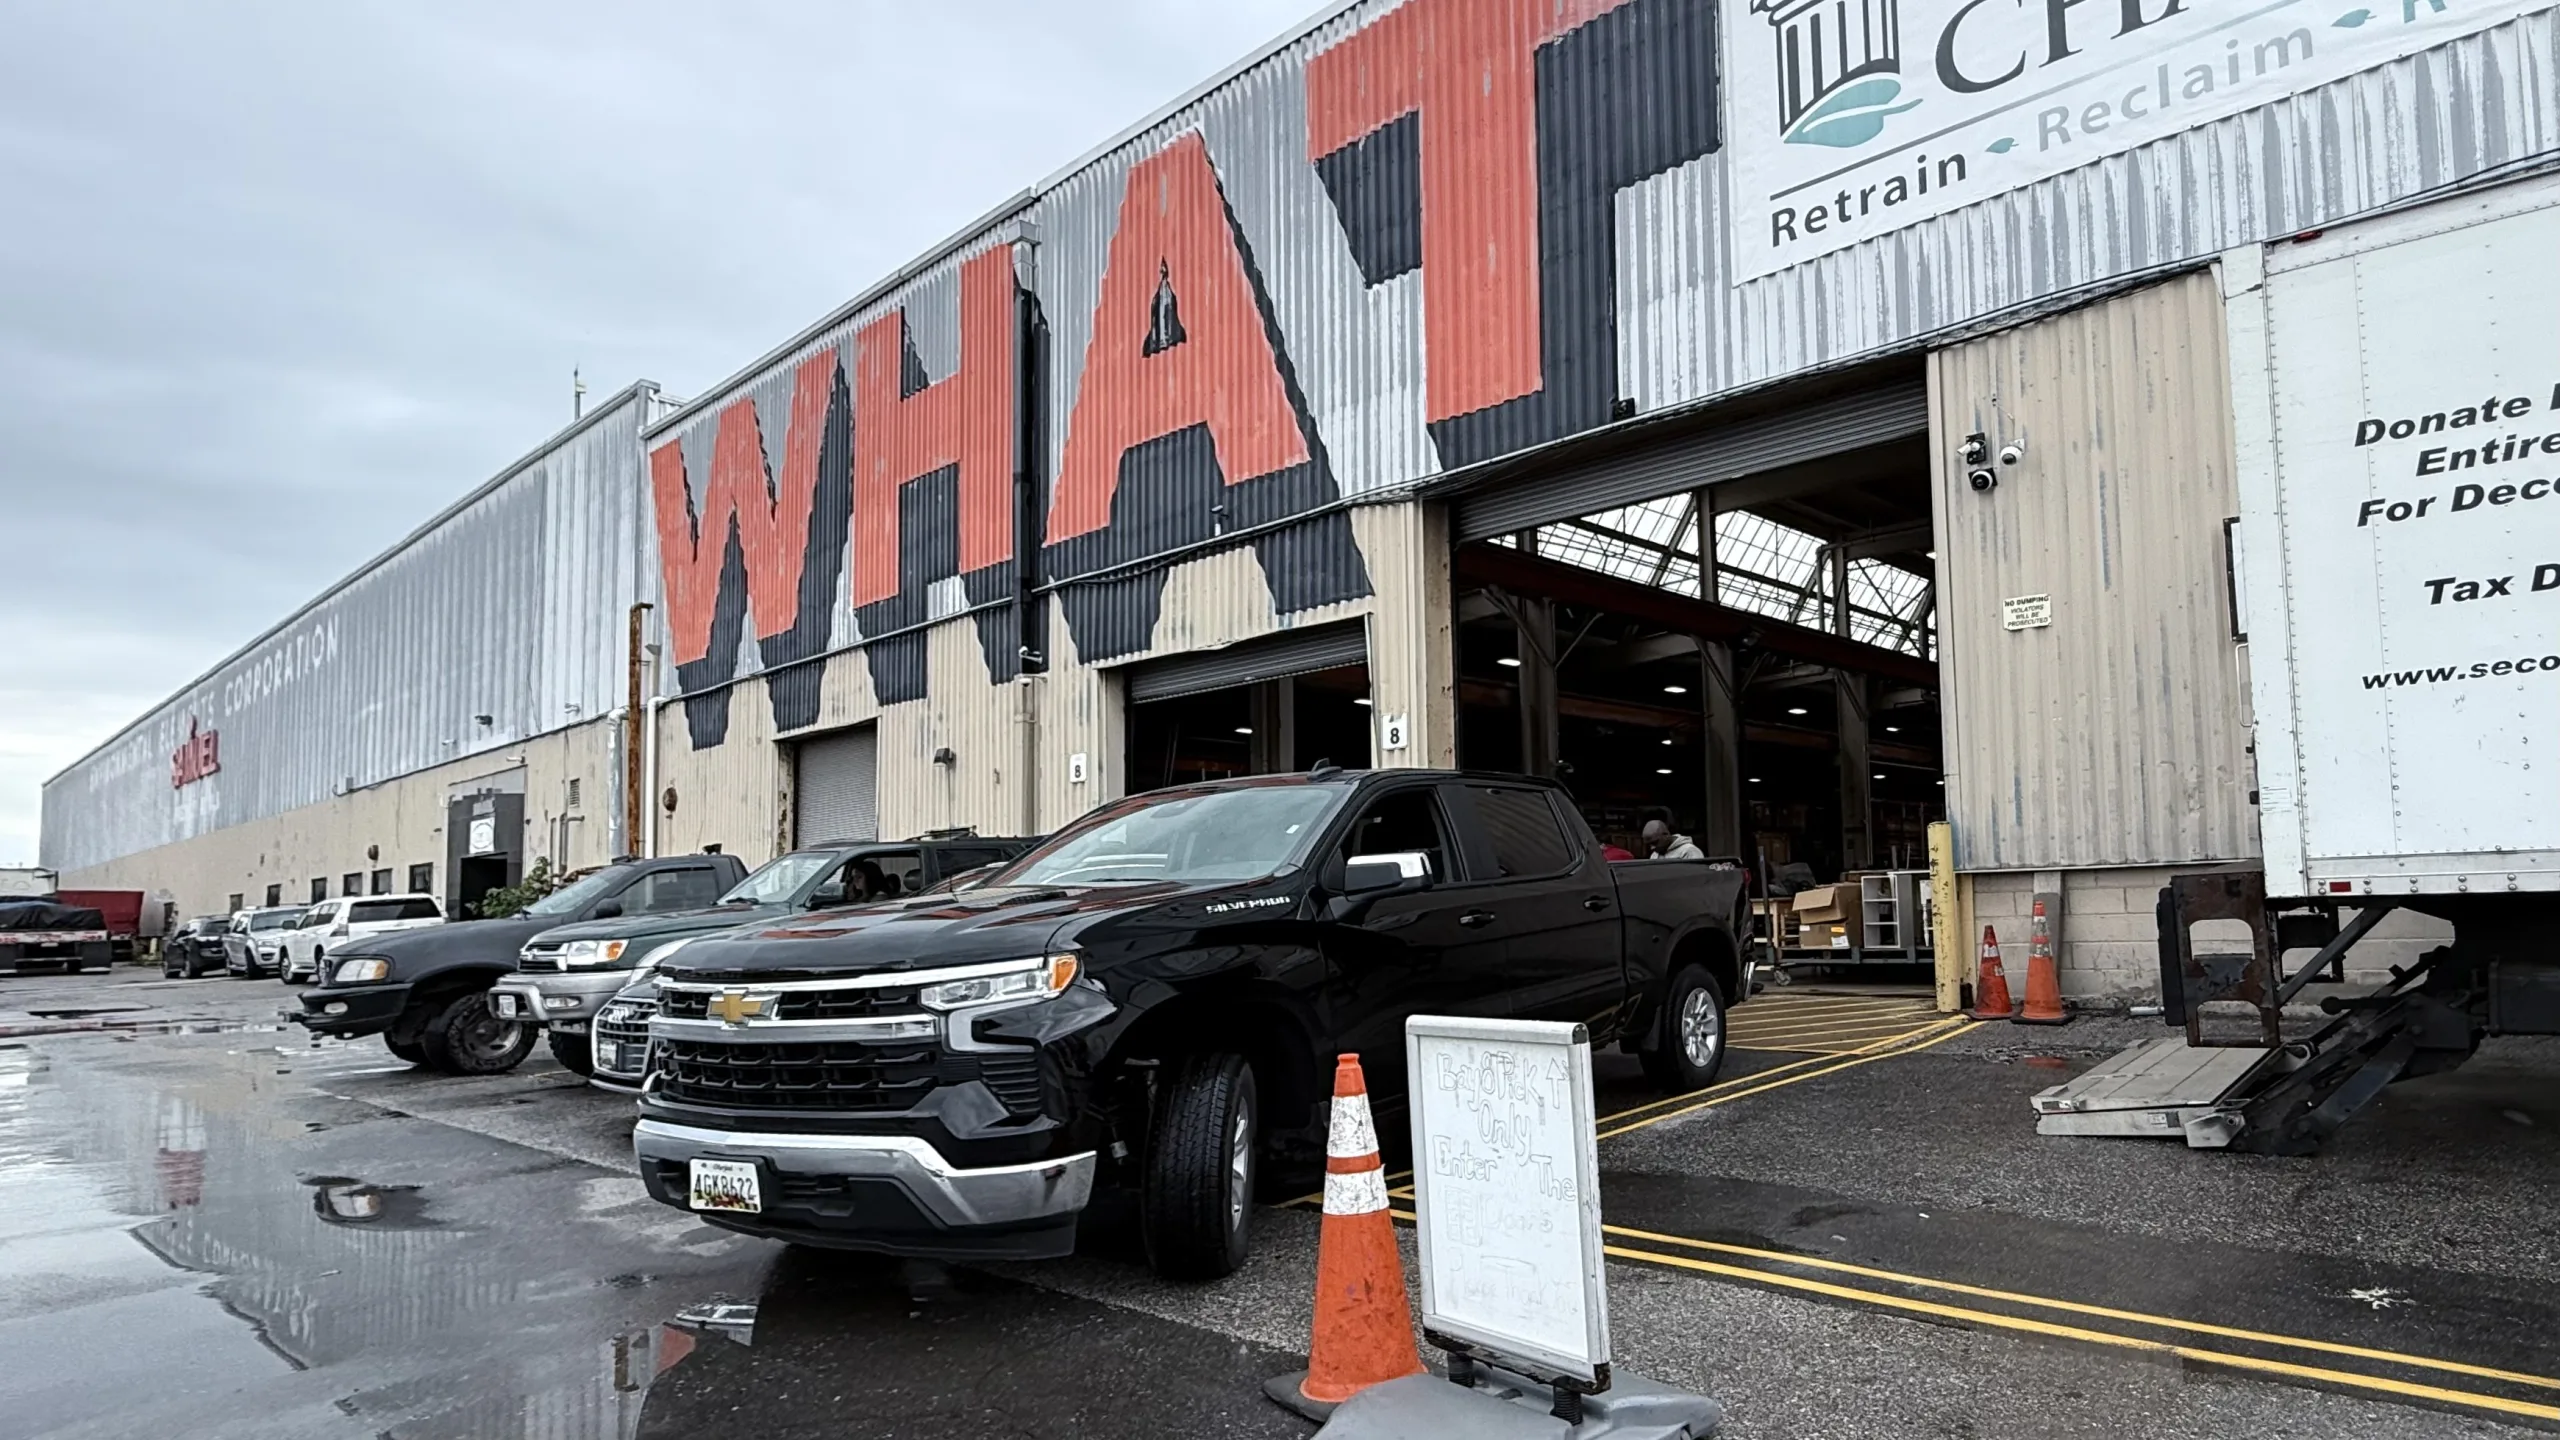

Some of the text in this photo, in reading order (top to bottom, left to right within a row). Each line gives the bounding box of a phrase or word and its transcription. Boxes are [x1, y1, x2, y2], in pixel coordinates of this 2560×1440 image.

[1772, 27, 2314, 248] Retrain Reclaim
[650, 0, 1640, 675] WHAT
[2355, 396, 2532, 447] Donate
[2416, 434, 2560, 477] Entire
[2357, 496, 2437, 527] For
[2011, 604, 2044, 613] VIOLATORS
[2017, 596, 2049, 605] DUMPING
[2424, 576, 2515, 605] Tax
[2008, 617, 2048, 627] PROSECUTED
[224, 613, 339, 717] CORPORATION
[1390, 727, 1400, 745] 8
[1074, 764, 1082, 778] 8
[1478, 1099, 1532, 1167] Only
[1433, 1134, 1577, 1201] Enter The
